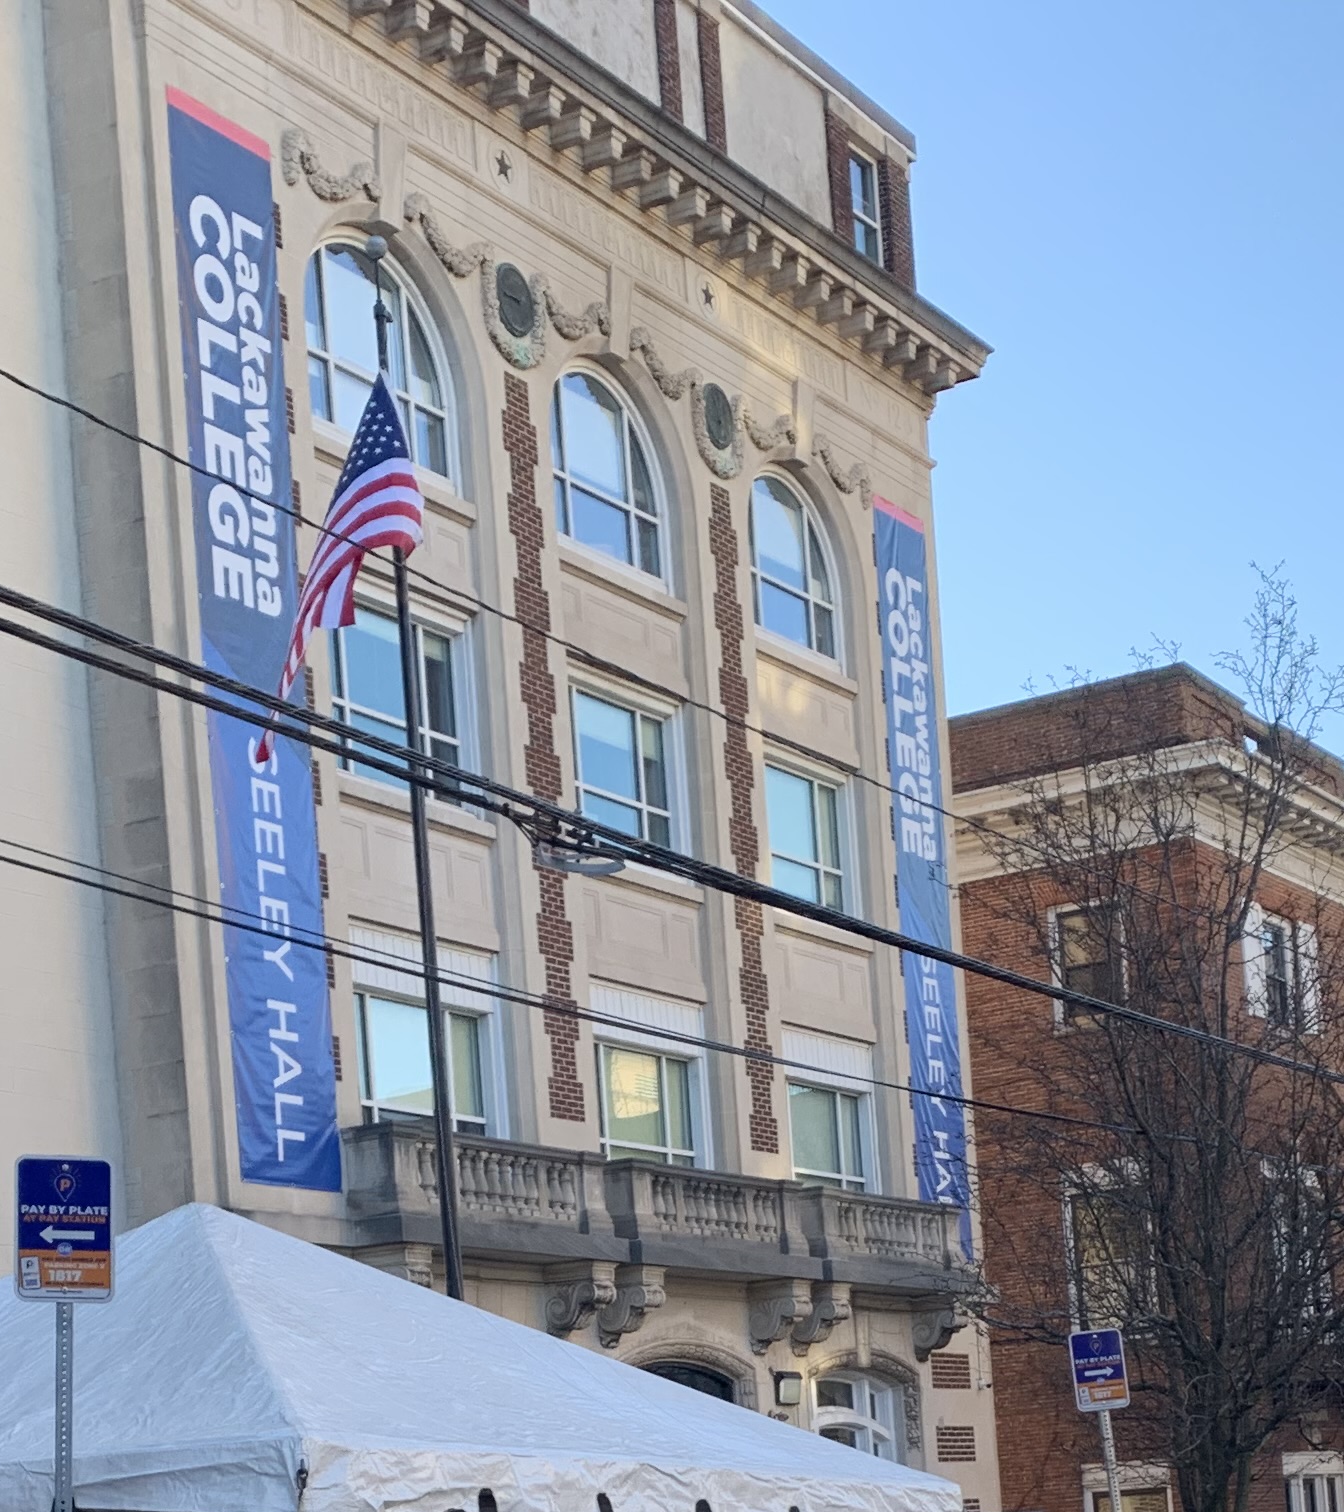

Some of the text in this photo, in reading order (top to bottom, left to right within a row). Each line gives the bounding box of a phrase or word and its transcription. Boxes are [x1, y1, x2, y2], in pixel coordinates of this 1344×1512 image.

[189, 194, 255, 611] COLLEGE
[230, 211, 283, 618] Lackawanna
[885, 567, 922, 857] COLLEGE
[906, 574, 937, 861] Lackawanna
[246, 736, 305, 1161] SEELEY HALL
[919, 954, 954, 1204] SEELEY HA
[21, 1204, 108, 1216] PAY BY PLATE
[62, 1214, 107, 1225] STATION
